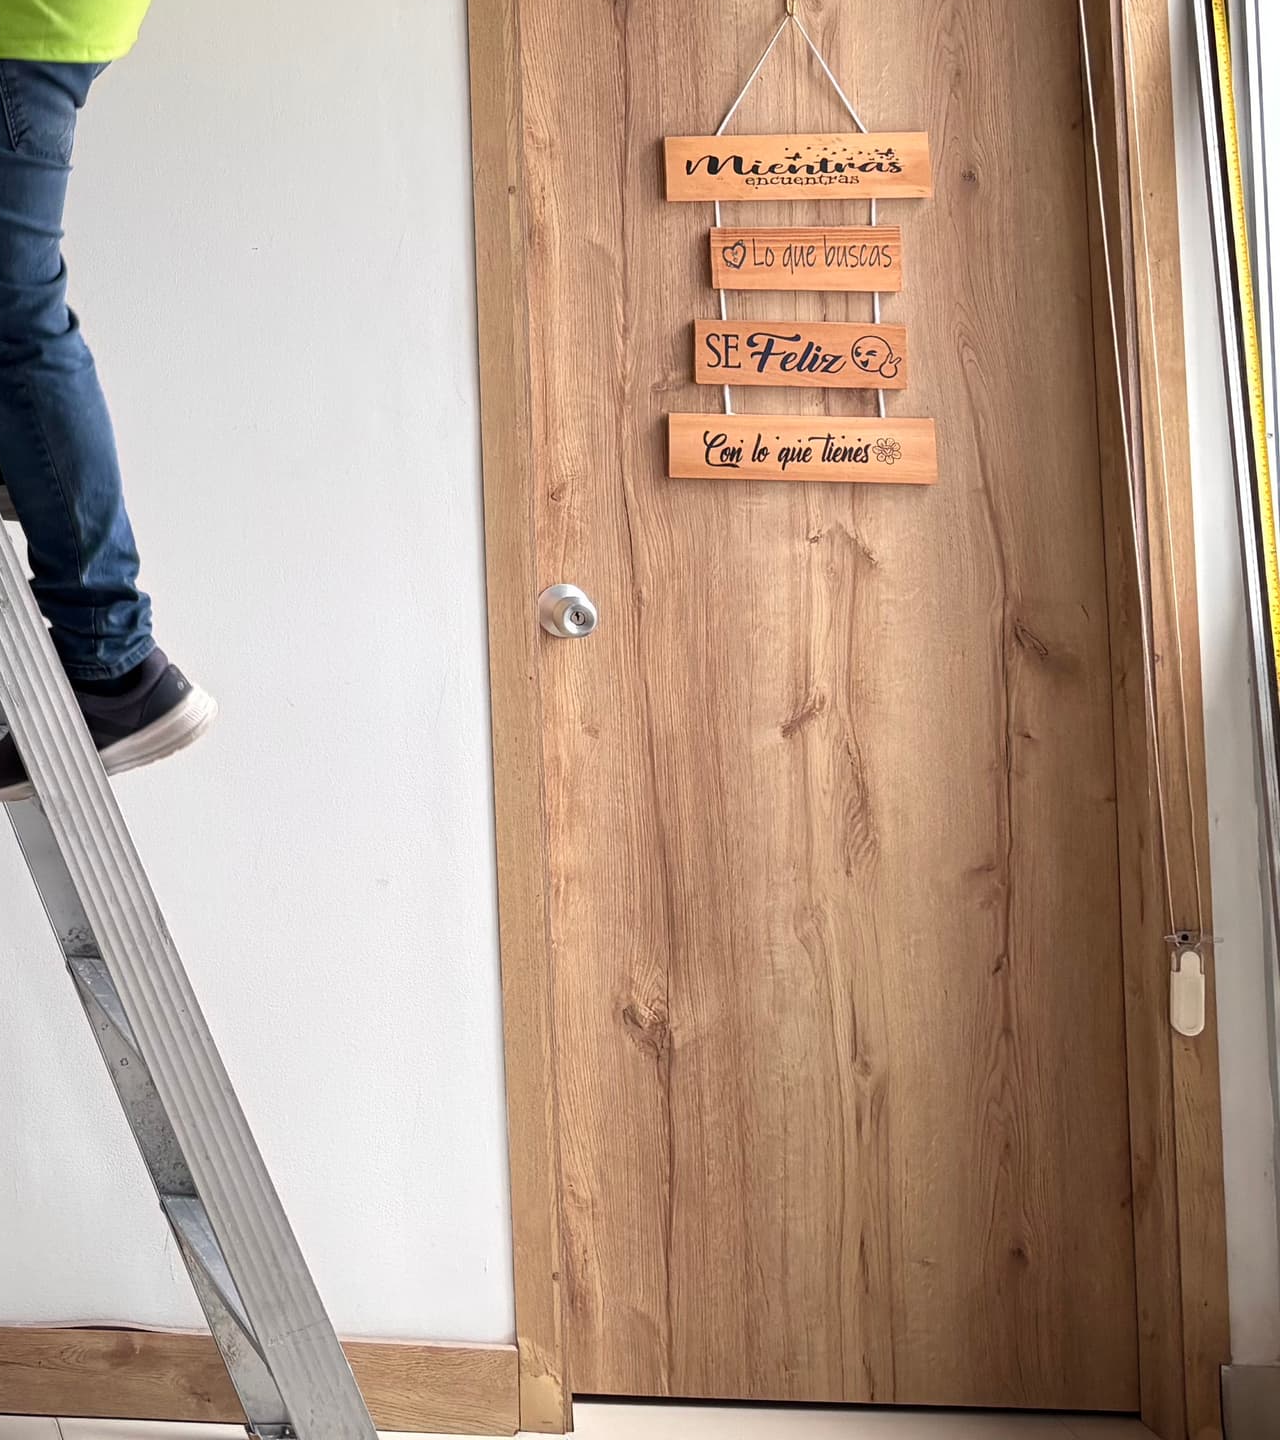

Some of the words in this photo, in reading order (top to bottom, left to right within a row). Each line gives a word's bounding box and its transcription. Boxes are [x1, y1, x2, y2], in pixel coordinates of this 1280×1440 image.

[686, 152, 904, 176] Mientras
[745, 174, 860, 187] encuentras
[752, 238, 775, 268] Lo
[782, 243, 817, 275] que
[823, 235, 893, 268] buscas
[705, 332, 742, 369] SE
[746, 332, 847, 373] Feliz
[703, 430, 743, 468] Con
[751, 433, 770, 462] lo
[777, 439, 813, 471] que
